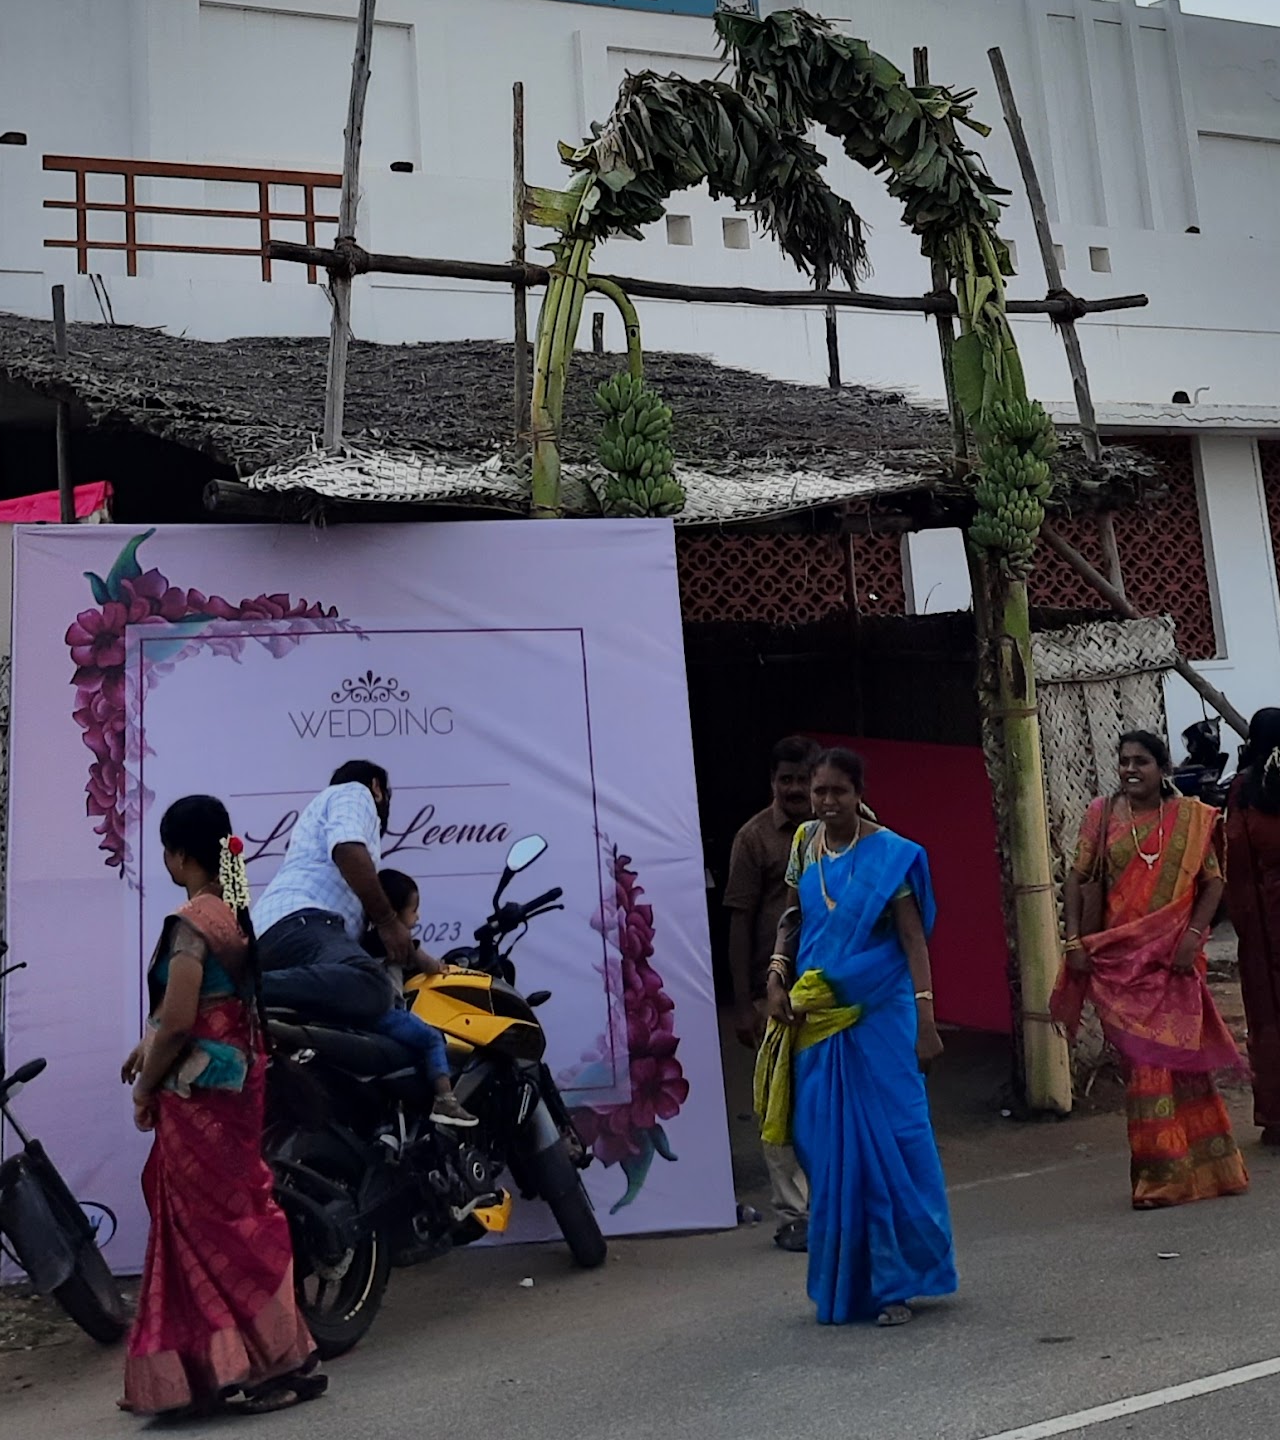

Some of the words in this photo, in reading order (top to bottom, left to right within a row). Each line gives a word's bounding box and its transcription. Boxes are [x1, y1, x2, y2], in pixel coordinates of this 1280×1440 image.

[288, 706, 453, 738] WEDDING
[380, 804, 511, 859] Leema
[410, 921, 462, 943] 2023
